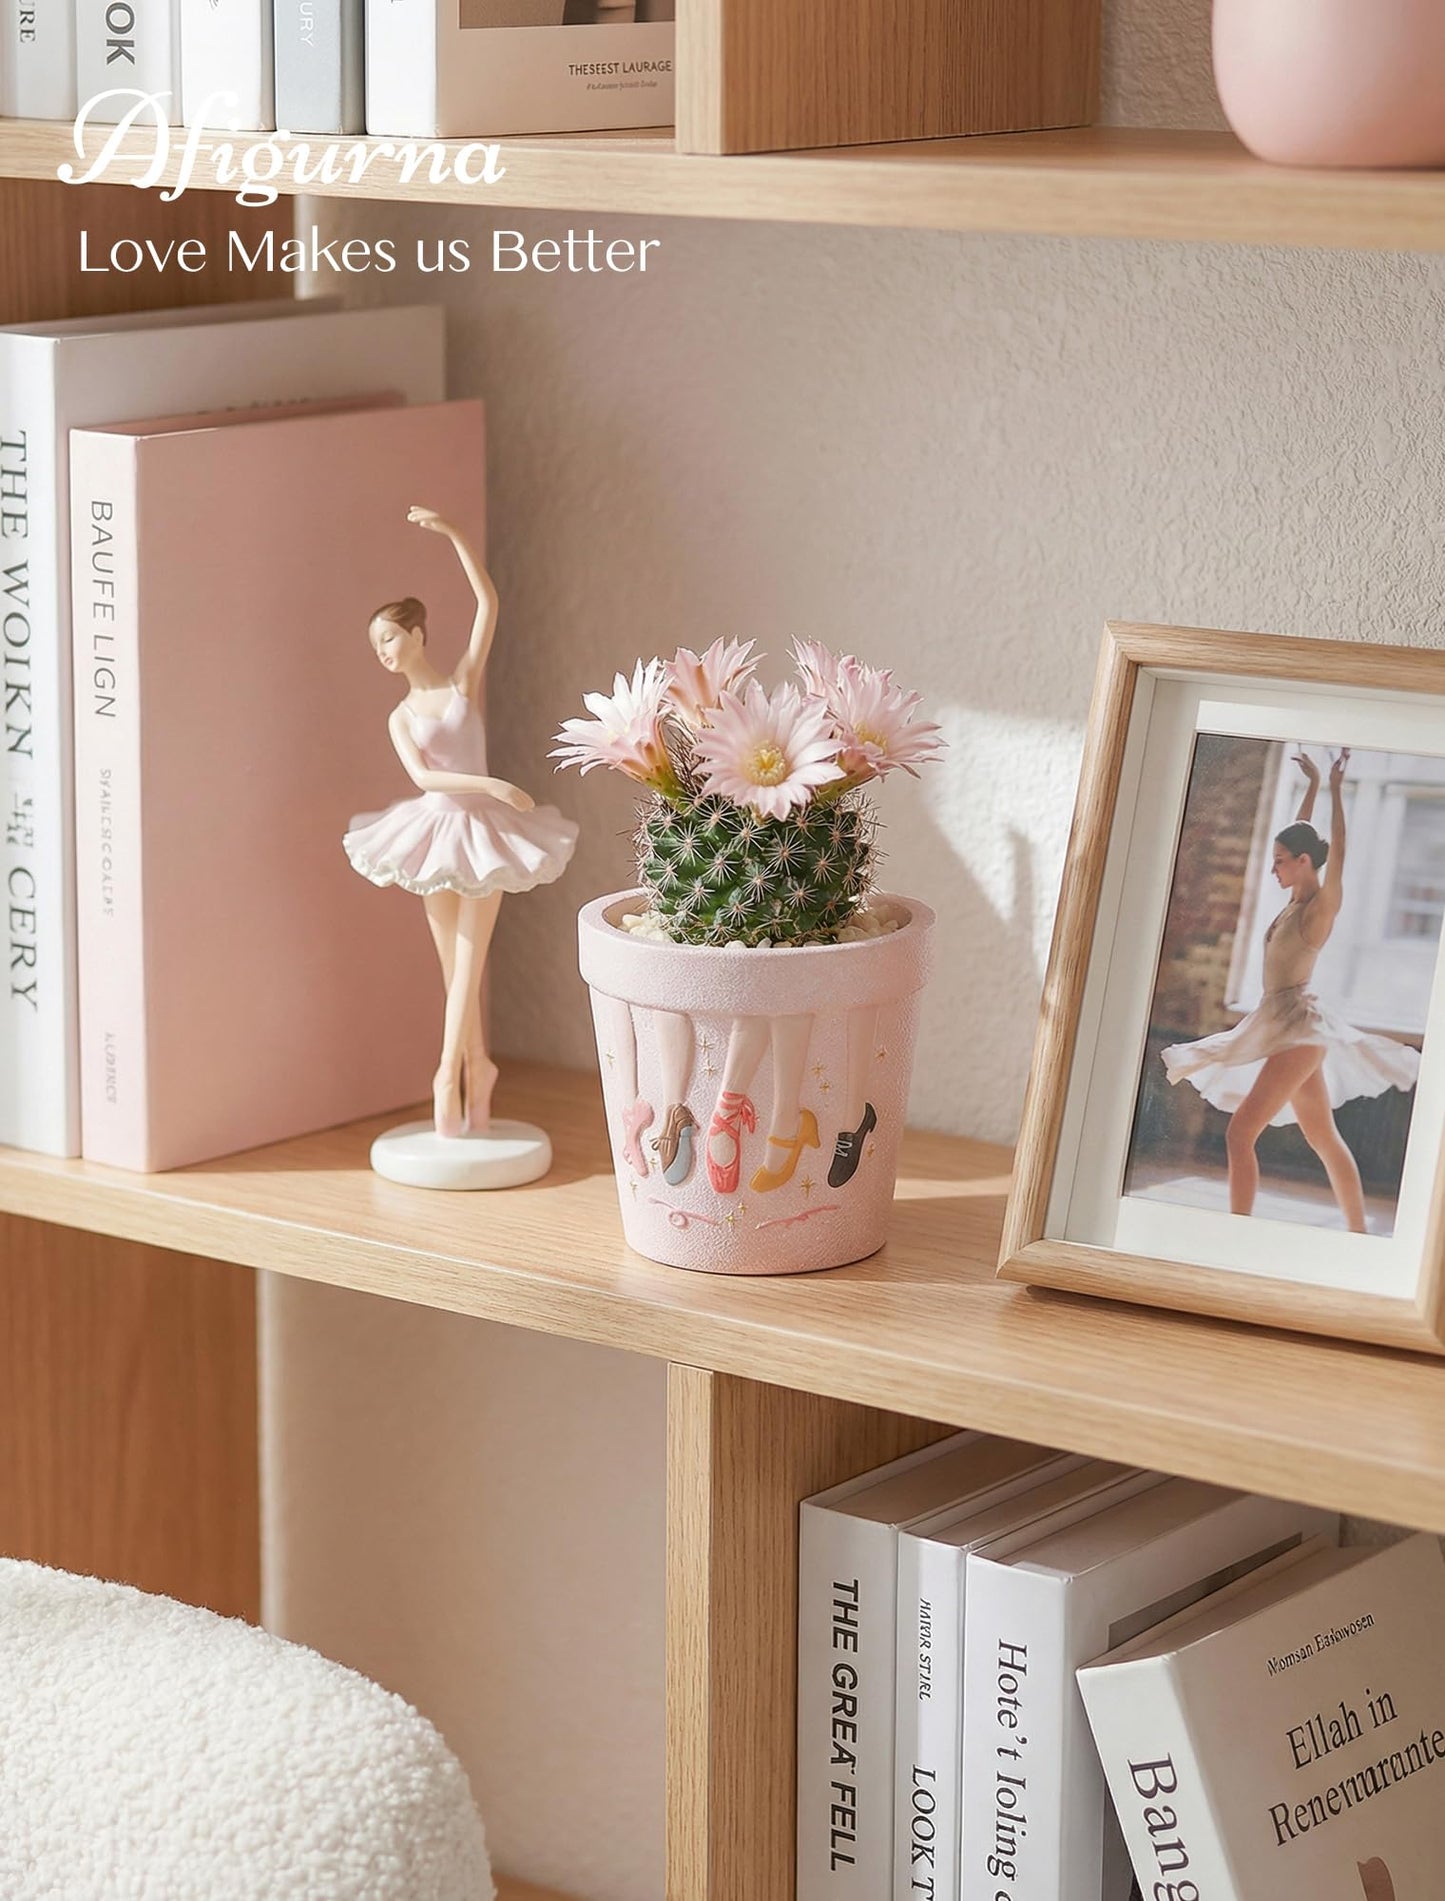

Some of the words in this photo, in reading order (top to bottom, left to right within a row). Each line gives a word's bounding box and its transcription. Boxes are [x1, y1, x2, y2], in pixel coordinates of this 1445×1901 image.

[105, 2, 135, 66] OK
[1, 430, 29, 539] THE
[91, 500, 115, 621] BAUFE
[93, 634, 117, 718] LIGN
[8, 866, 39, 1012] CERY
[832, 1579, 859, 1653] THE
[1285, 1700, 1364, 1770] Ellah
[1364, 1687, 1399, 1730] in
[830, 1781, 857, 1871] FELL
[911, 1763, 937, 1869] LOOK
[1127, 1751, 1201, 1901] Bang
